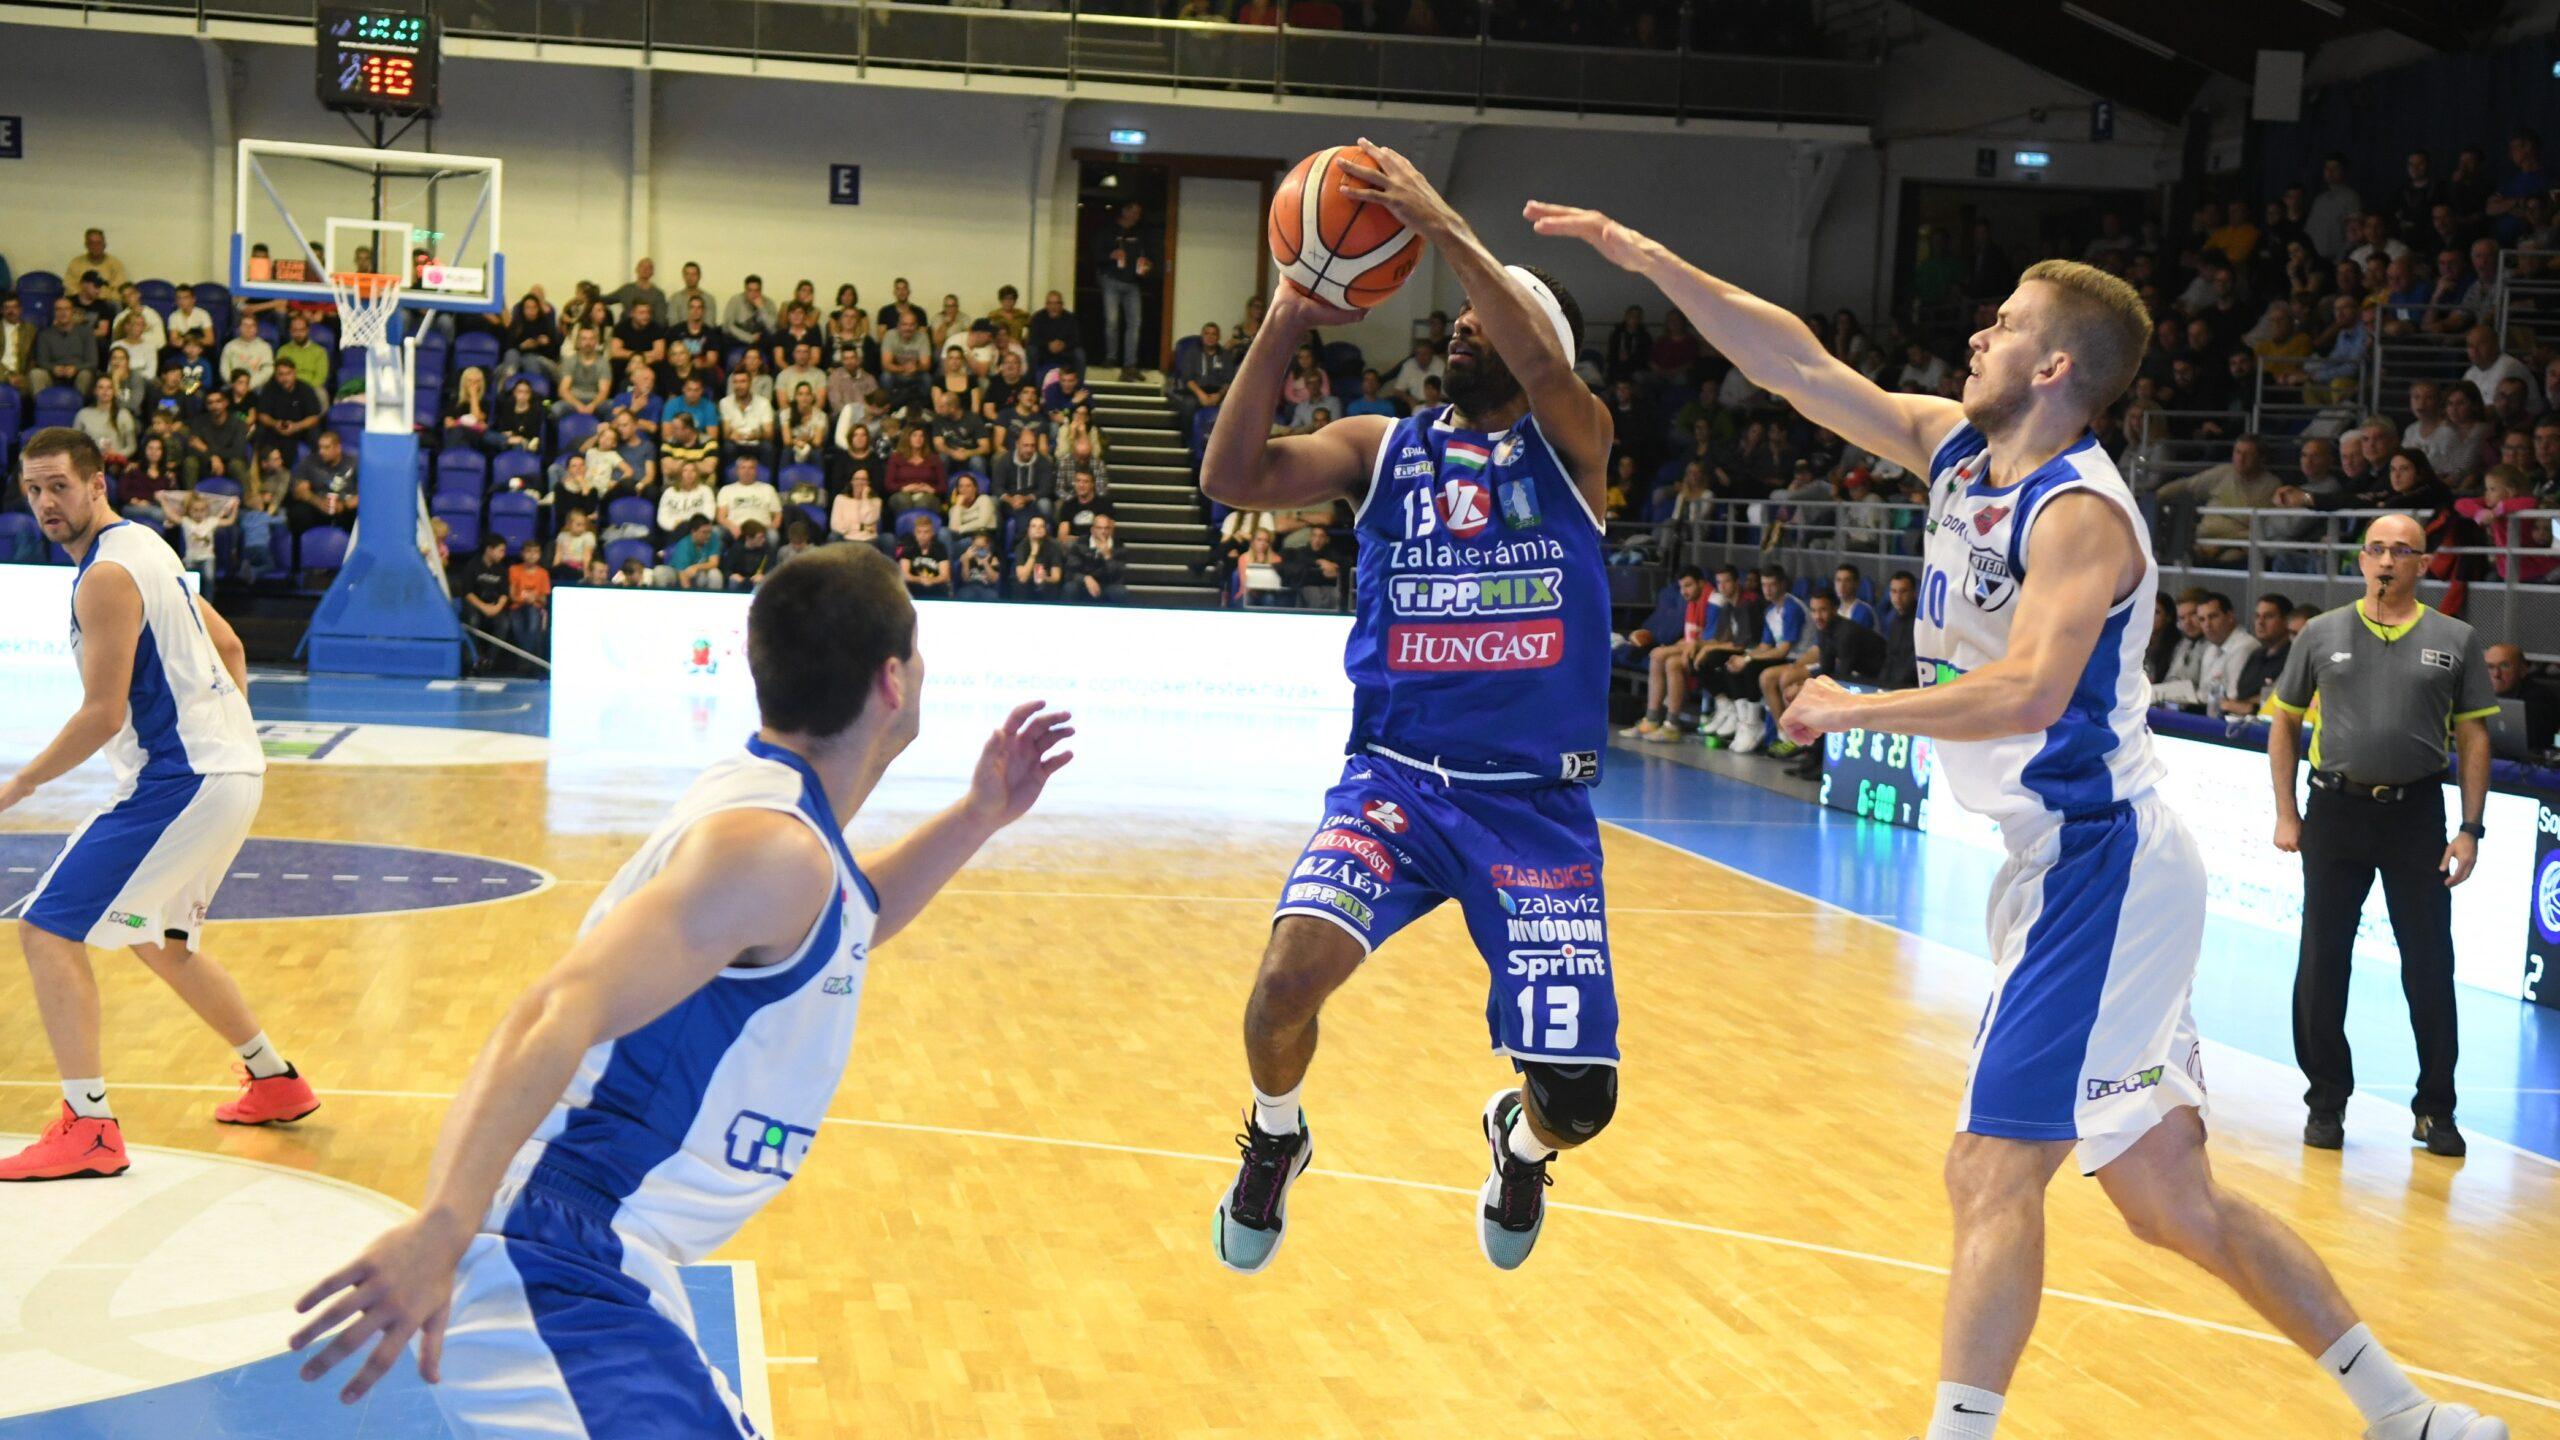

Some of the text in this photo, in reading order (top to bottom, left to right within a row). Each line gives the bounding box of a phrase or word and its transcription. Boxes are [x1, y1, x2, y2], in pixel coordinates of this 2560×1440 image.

[838, 168, 852, 195] E
[1403, 486, 1436, 539] 13
[1942, 514, 1972, 544] DOR
[1389, 534, 1564, 568] Zalakerámia
[2538, 806, 2560, 841] So
[1489, 863, 1595, 889] SZABADICS
[1518, 893, 1600, 915] zalavíz
[1507, 944, 1606, 982] Sprint
[2524, 954, 2544, 1001] 2
[1517, 985, 1580, 1049] 13
